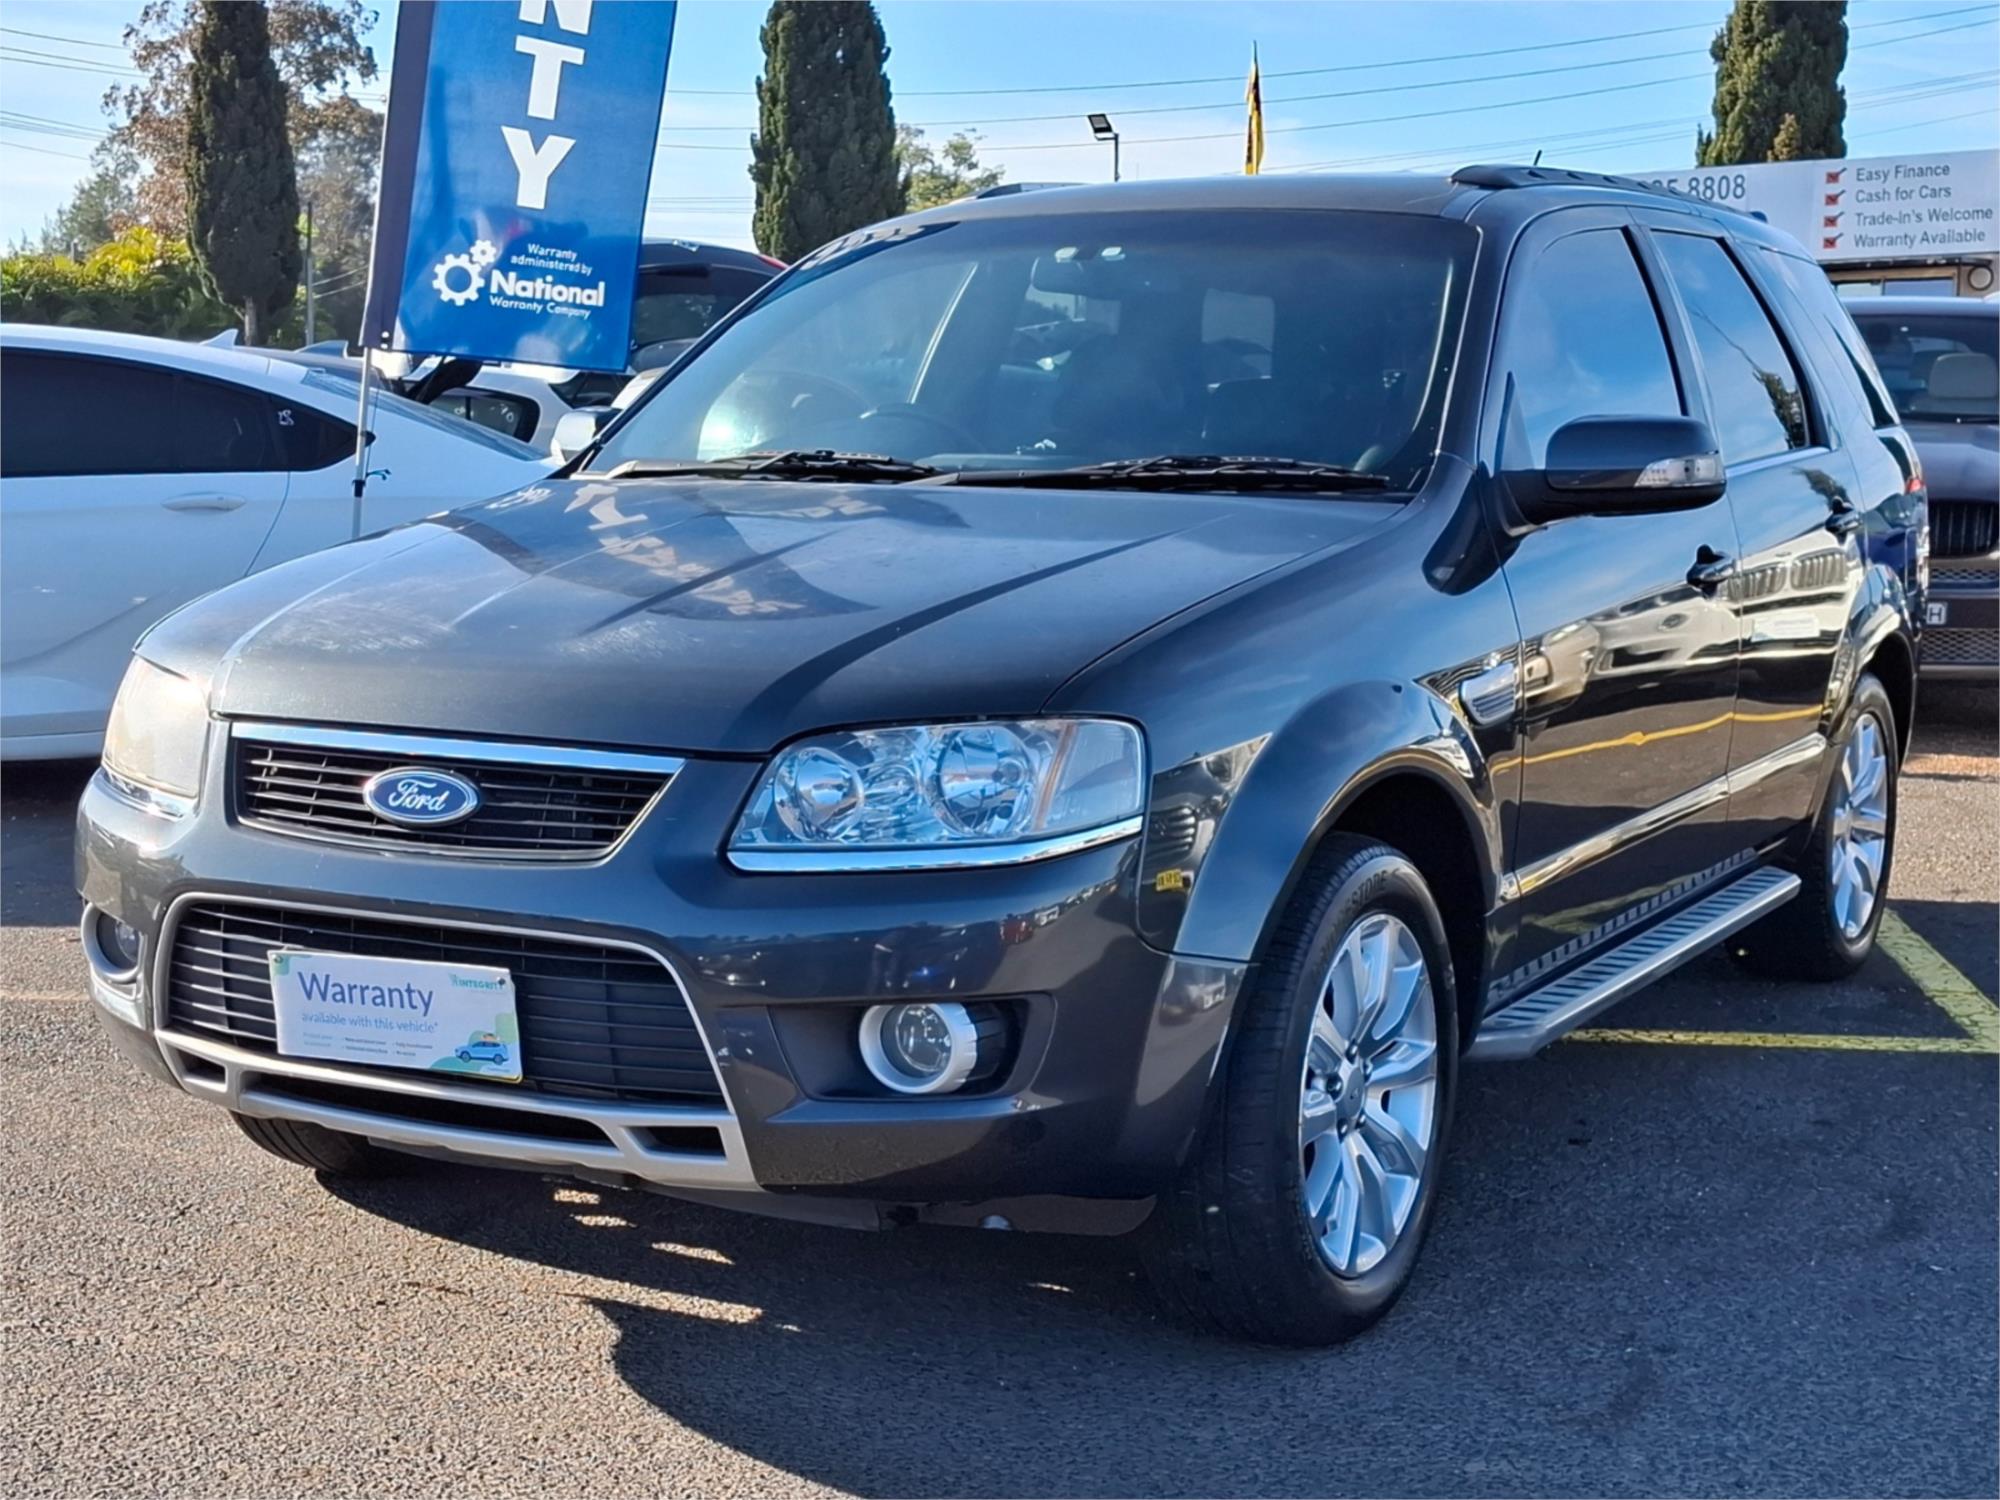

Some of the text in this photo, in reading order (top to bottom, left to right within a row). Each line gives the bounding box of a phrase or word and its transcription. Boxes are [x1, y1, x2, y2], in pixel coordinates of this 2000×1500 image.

[1856, 164, 1950, 184] Easy Finance
[1687, 174, 1746, 201] 8808
[1855, 185, 1952, 204] Cash for Cars
[1927, 207, 1993, 223] Welcome
[1854, 229, 1986, 249] Warranty Available
[527, 243, 578, 261] Warranty
[510, 255, 593, 277] administered by
[490, 269, 606, 308] National
[489, 295, 592, 320] Warranty Company
[388, 778, 450, 812] Ford
[297, 970, 433, 1017] Warranty
[301, 1012, 347, 1026] available
[349, 1014, 373, 1029] with
[375, 1017, 395, 1031] this
